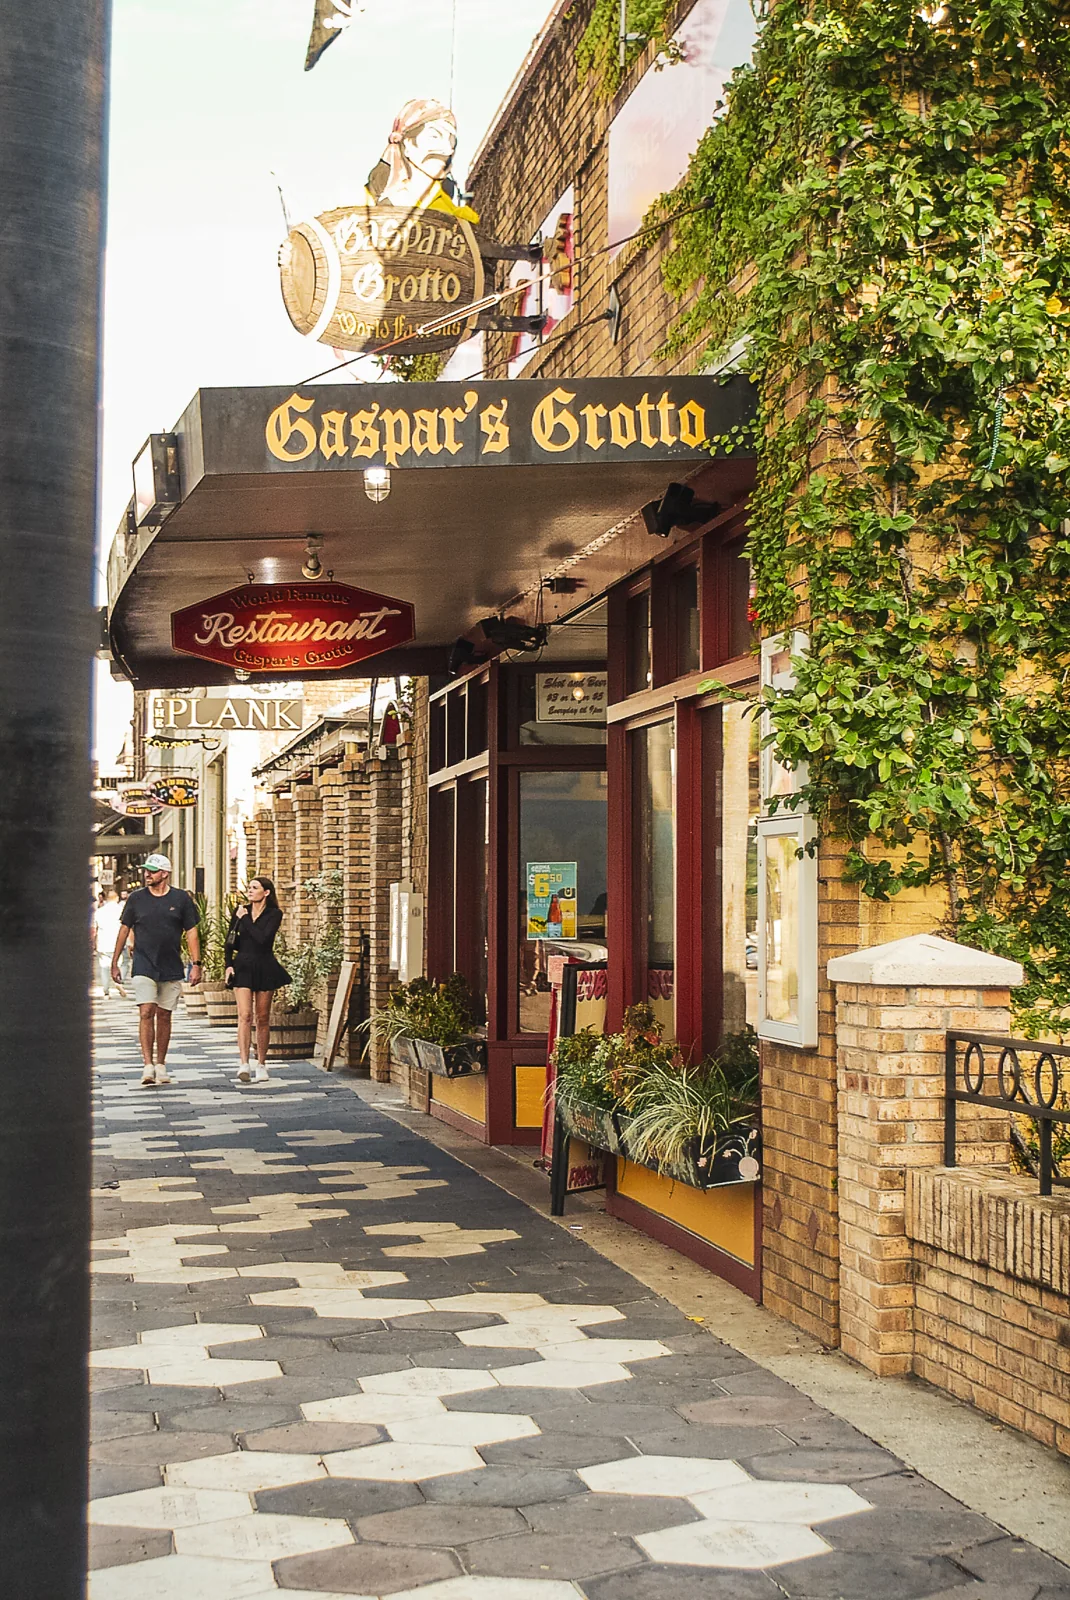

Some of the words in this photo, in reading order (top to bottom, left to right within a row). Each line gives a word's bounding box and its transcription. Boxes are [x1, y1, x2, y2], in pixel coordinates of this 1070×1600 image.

[335, 213, 466, 259] Gaspar's
[353, 261, 461, 303] Grotto
[336, 311, 390, 339] World
[393, 315, 461, 340] Faous
[265, 390, 510, 468] Gaspar's
[531, 387, 706, 452] Grotto
[230, 590, 284, 609] World
[287, 589, 352, 605] Famous
[194, 606, 402, 648] Restaurant
[233, 648, 300, 670] Gaspar's
[304, 645, 354, 665] Grotto
[543, 677, 566, 688] Shot
[567, 677, 586, 688] and
[154, 698, 165, 728] THE
[165, 698, 300, 729] PLANK
